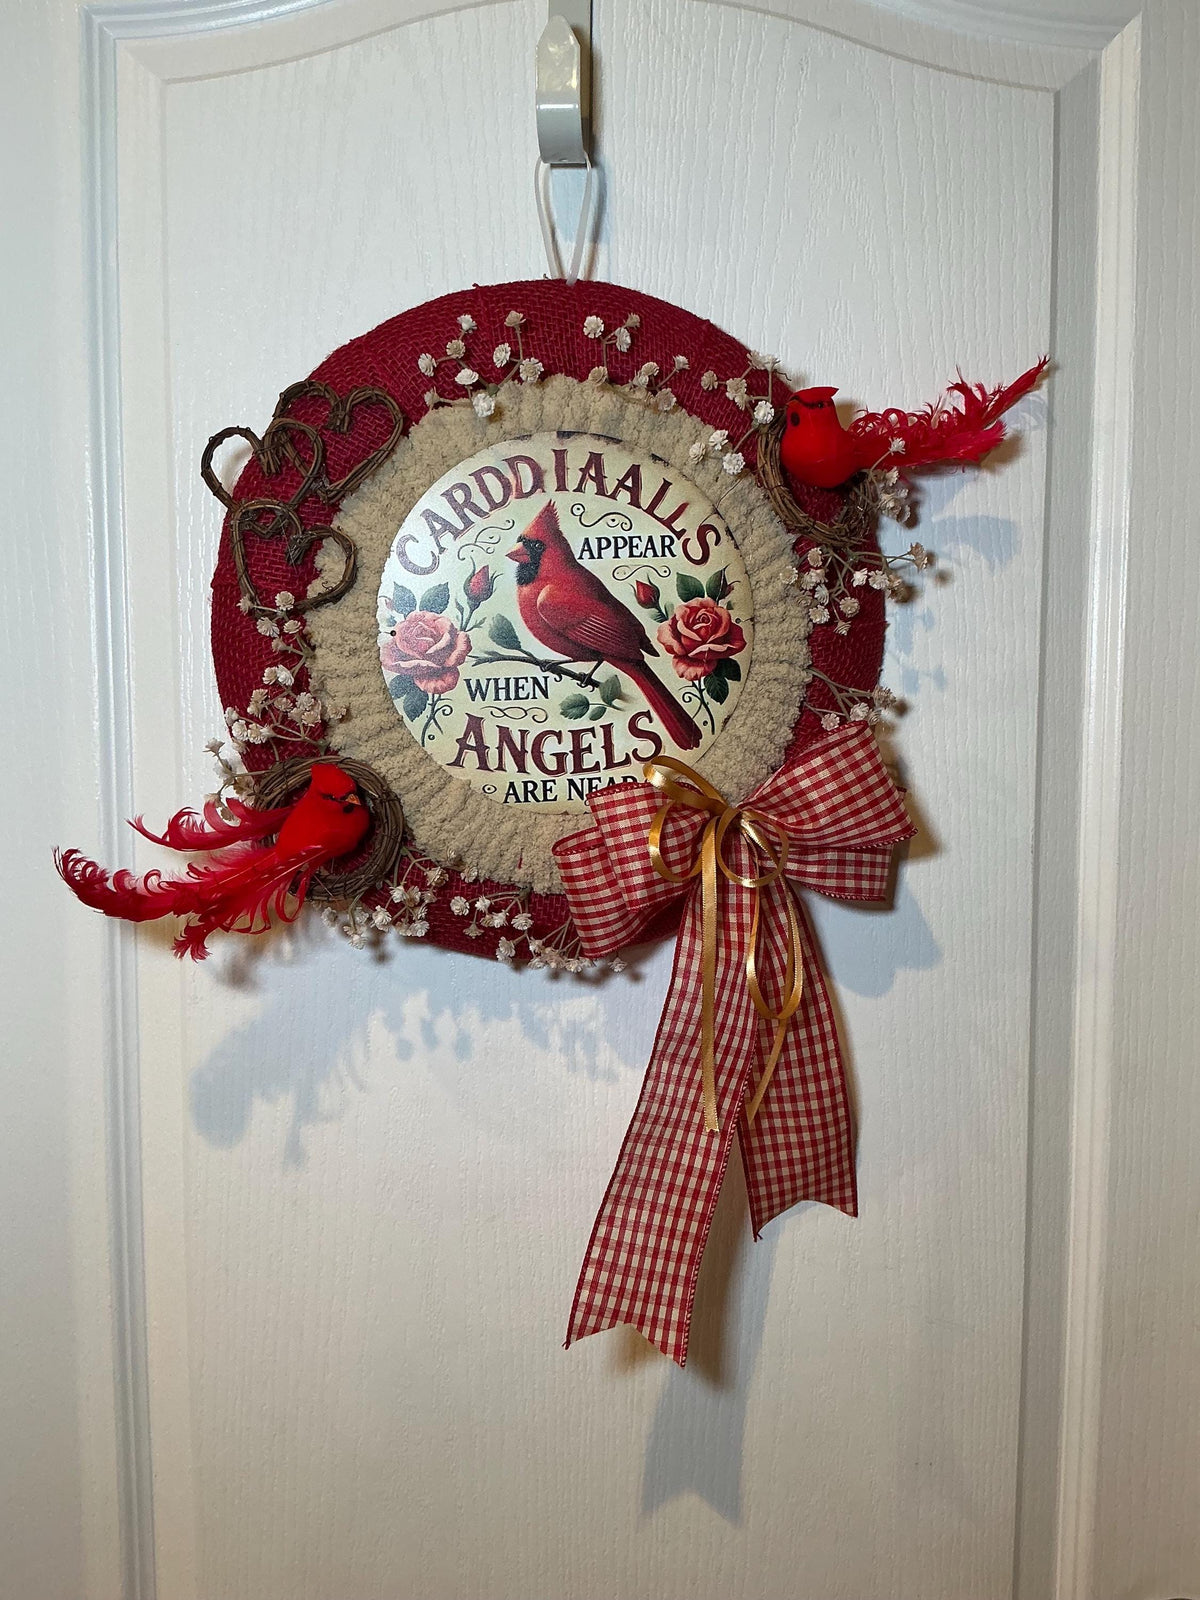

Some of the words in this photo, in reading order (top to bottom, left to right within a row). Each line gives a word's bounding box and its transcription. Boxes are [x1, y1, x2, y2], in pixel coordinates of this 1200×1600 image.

[577, 535, 677, 561] APPEAR
[463, 676, 550, 702] WHEN
[446, 710, 663, 777] ANGELS
[503, 779, 558, 803] ARE
